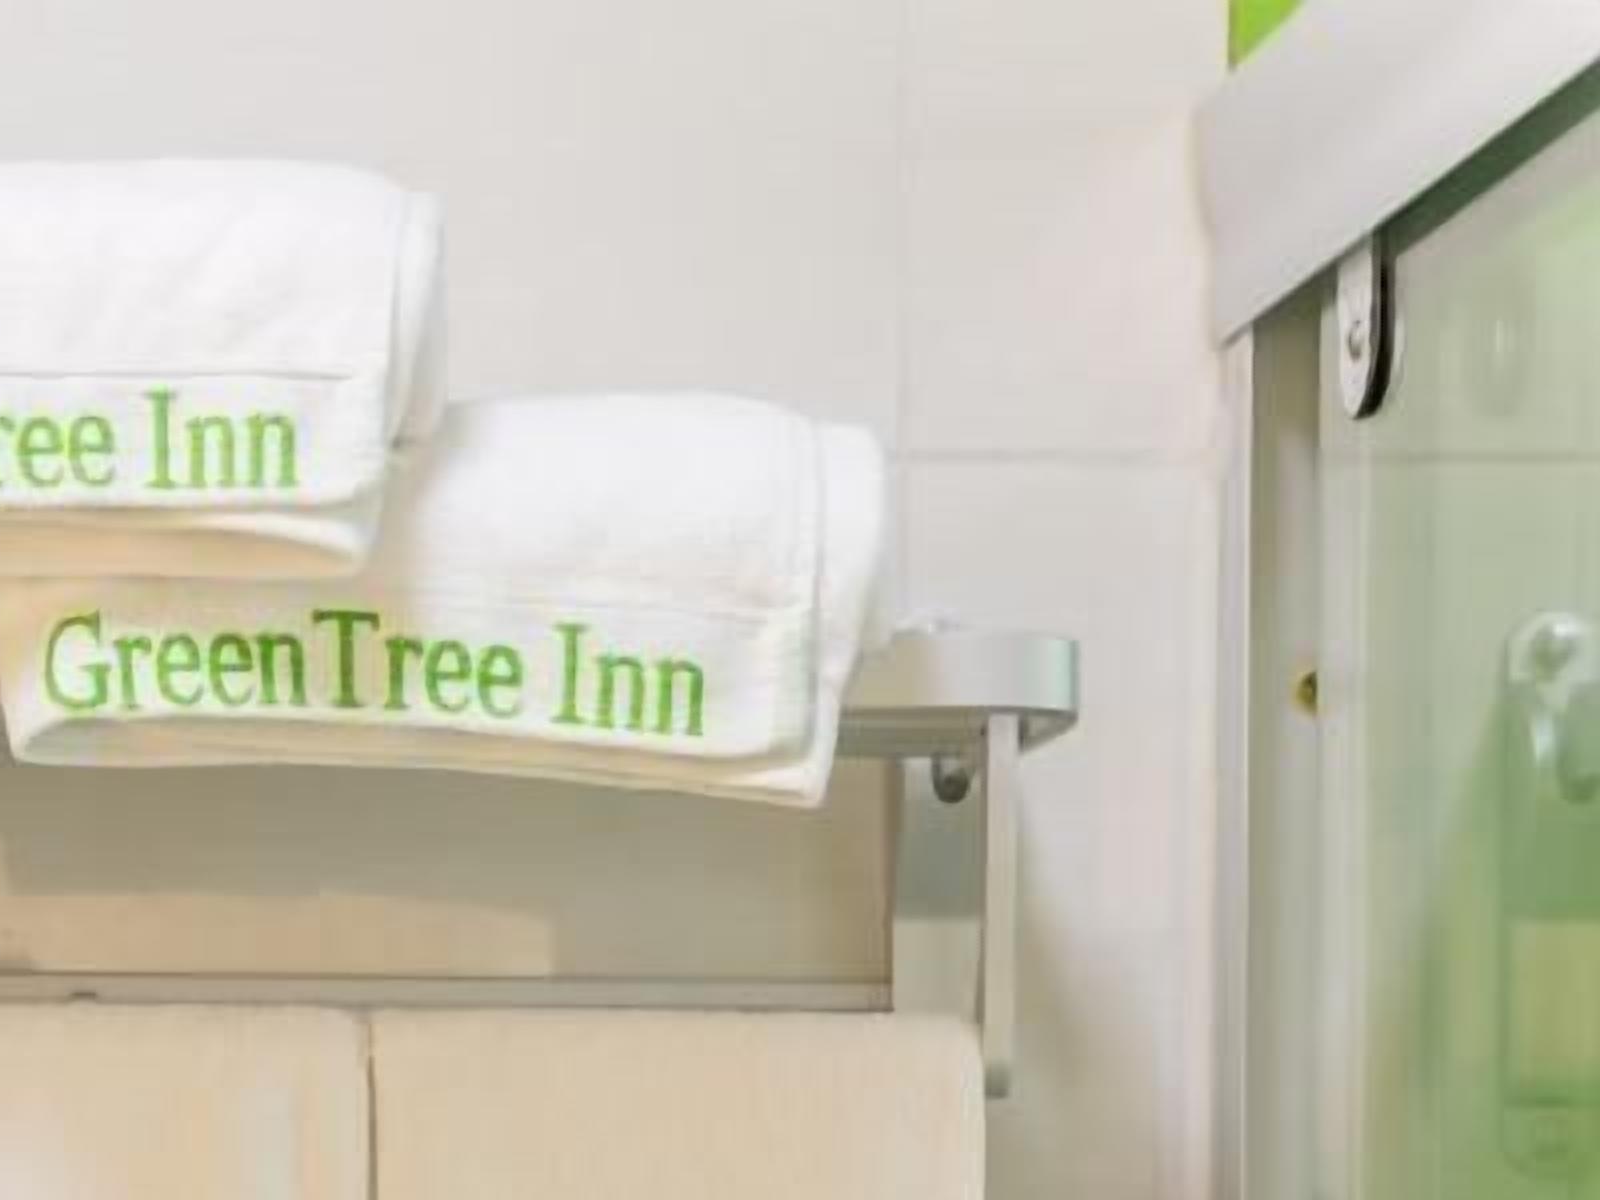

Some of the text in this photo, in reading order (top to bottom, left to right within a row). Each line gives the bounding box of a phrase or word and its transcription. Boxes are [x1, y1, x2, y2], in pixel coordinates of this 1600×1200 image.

[146, 387, 299, 491] Inn
[41, 606, 707, 738] GreenTree Inn
